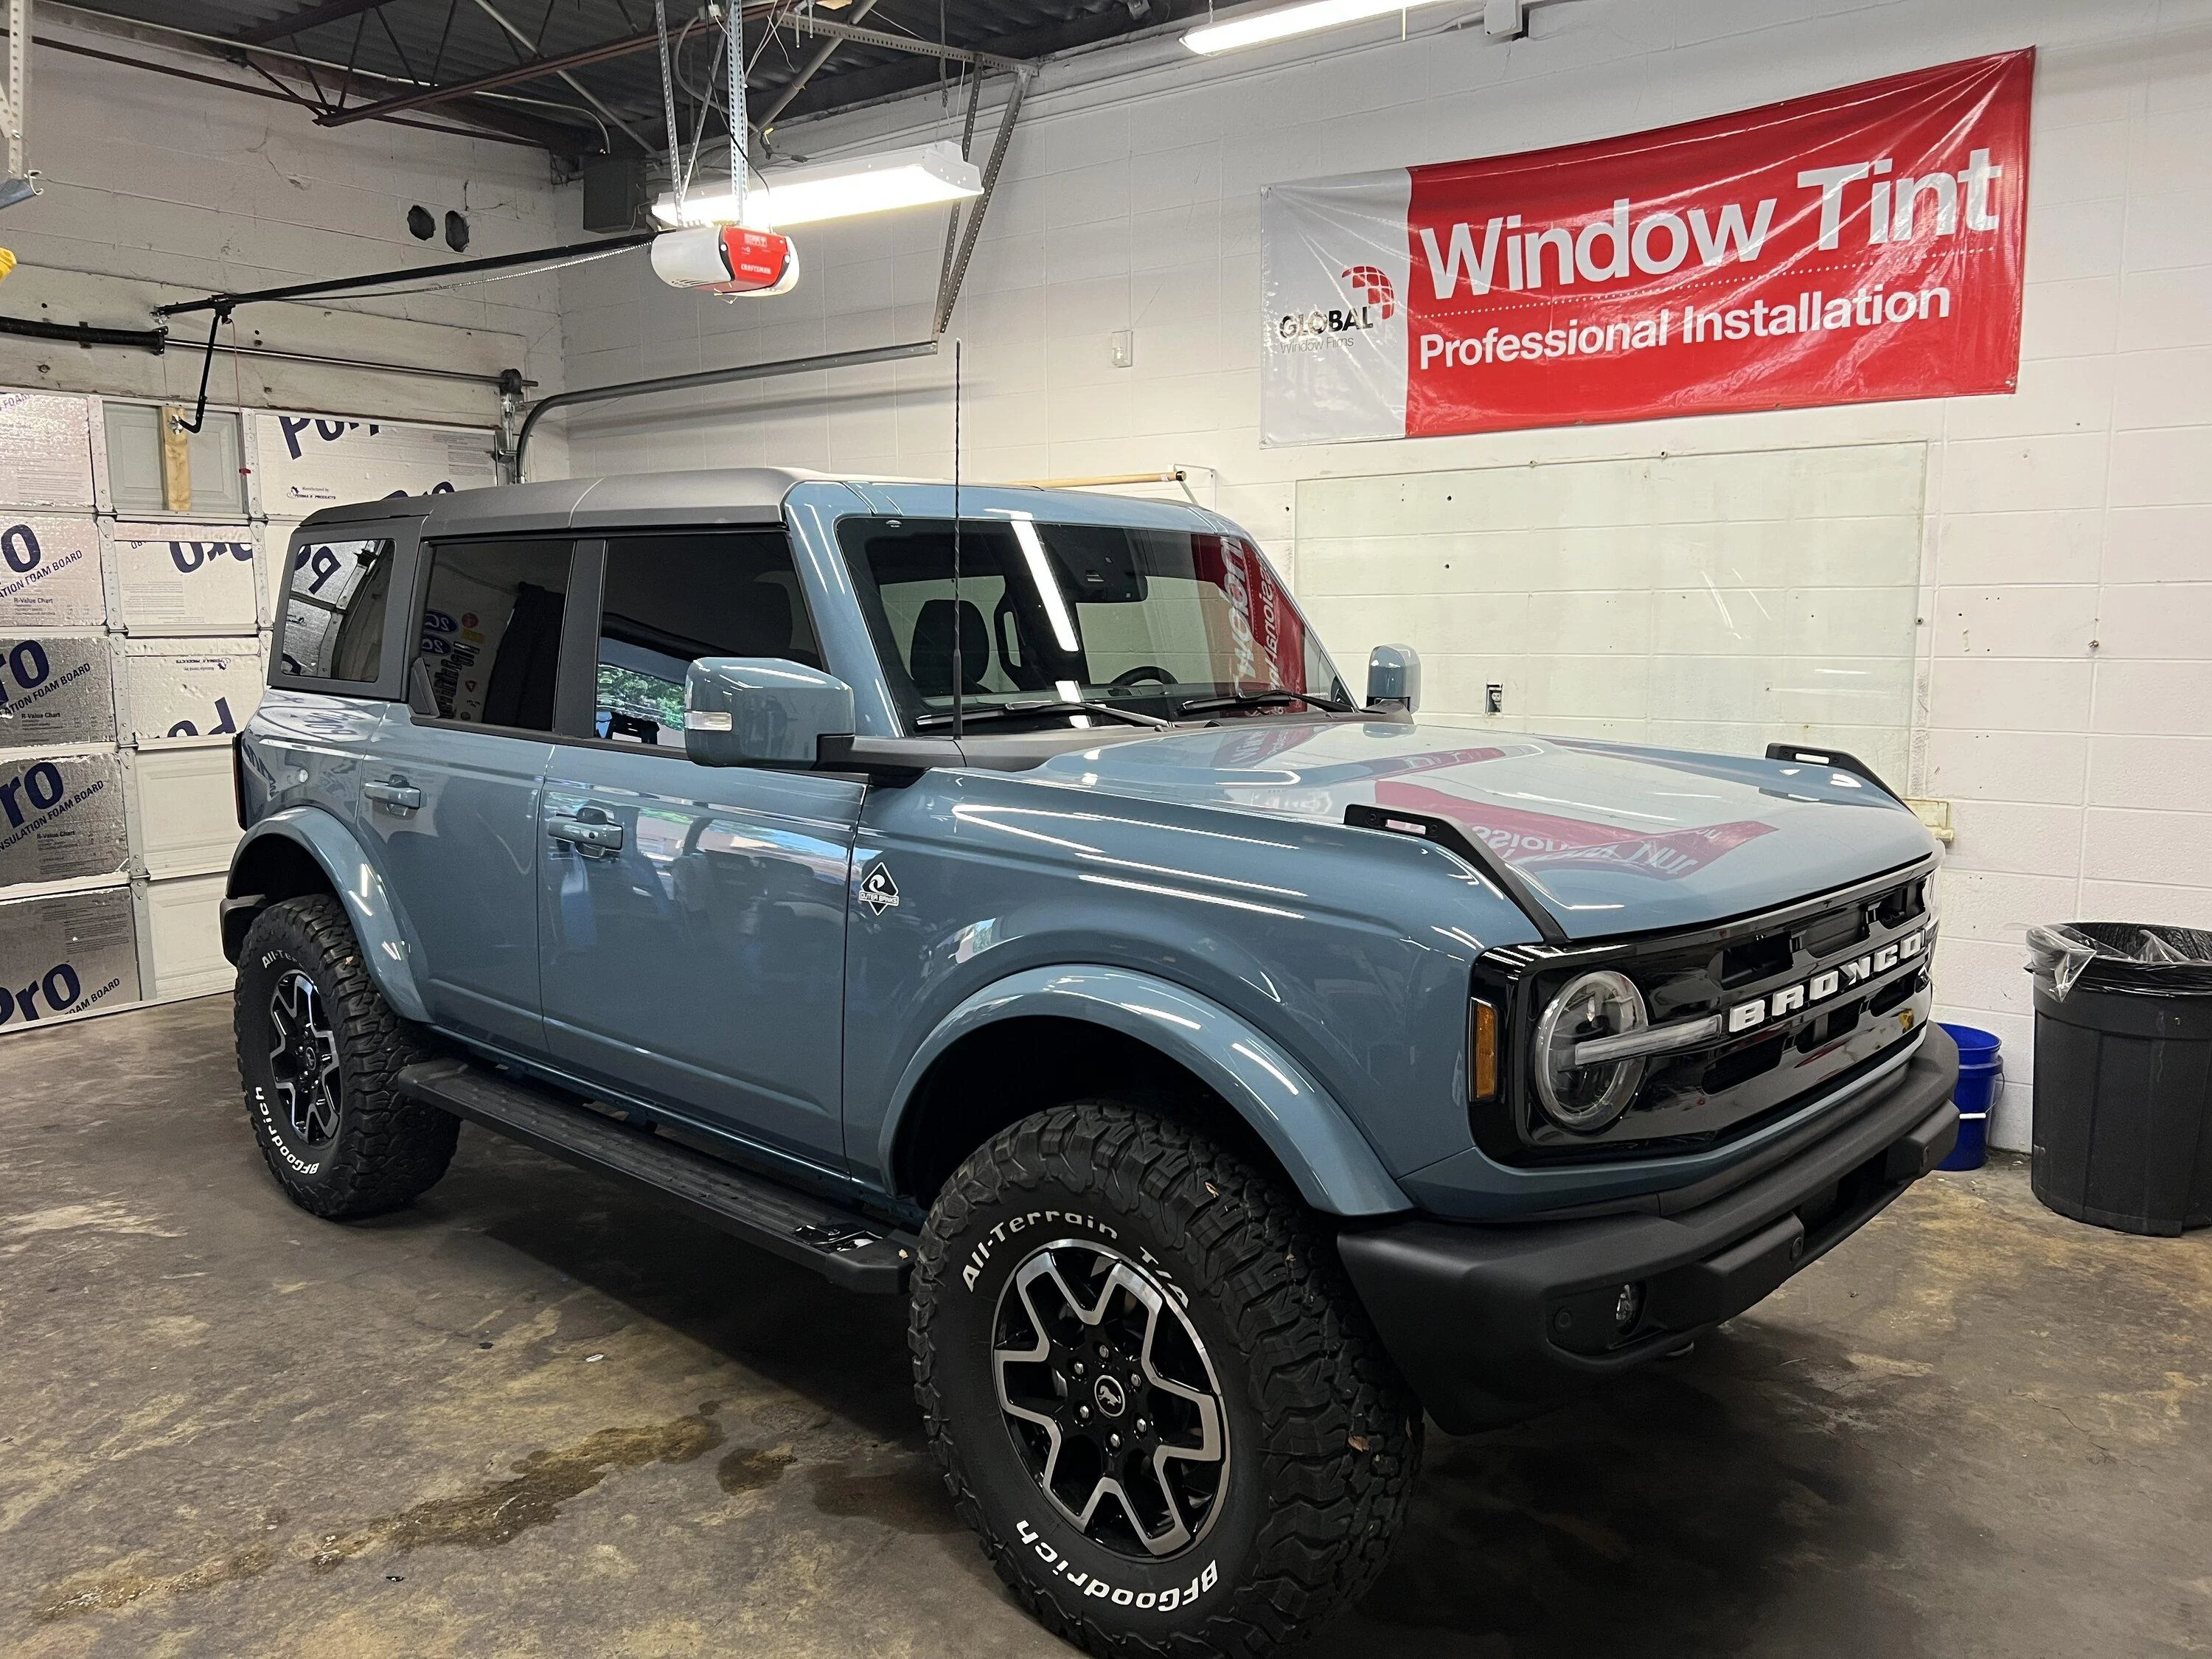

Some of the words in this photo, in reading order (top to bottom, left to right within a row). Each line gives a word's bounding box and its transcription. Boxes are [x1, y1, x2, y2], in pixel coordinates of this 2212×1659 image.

[1419, 198, 1778, 300] Window
[1797, 147, 2003, 251] Tint
[740, 263, 772, 275] CRAFTSMAN
[1279, 306, 1374, 338] GLOBAL
[1419, 308, 1669, 369] Professional
[1682, 284, 1950, 344] Installation
[1280, 340, 1324, 355] Window
[1326, 336, 1354, 349] Films
[25, 566, 52, 585] FOAM
[52, 549, 83, 571] BOARD
[32, 680, 60, 701] FOAM
[60, 663, 91, 686] BOARD
[47, 799, 74, 820] FOAM
[74, 780, 104, 804] BOARD
[860, 892, 878, 901] OUTER
[878, 894, 897, 904] BANKS
[91, 978, 121, 1003] BOARD
[1729, 932, 1924, 1033] BRONCO
[255, 1086, 320, 1175] BFGoodrich
[962, 1209, 1118, 1293] All-Terrain
[1015, 1519, 1218, 1612] BFGoodrich
